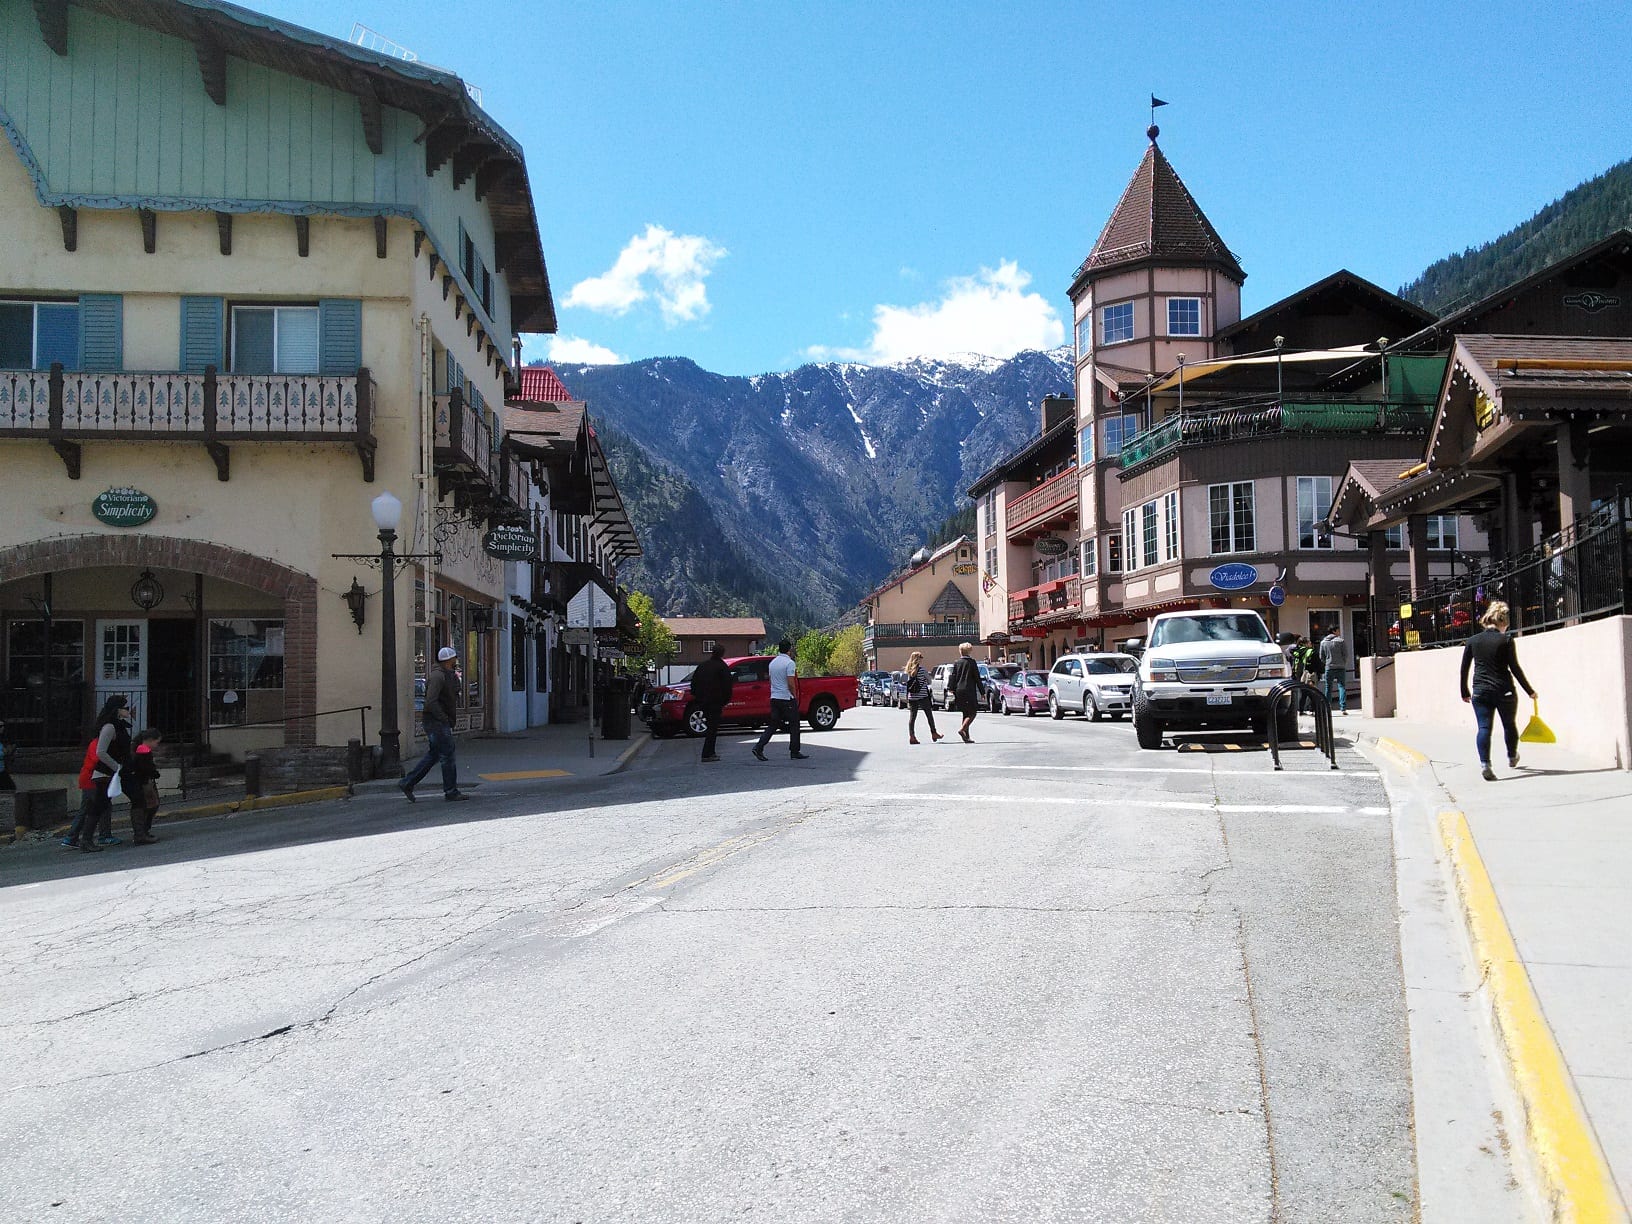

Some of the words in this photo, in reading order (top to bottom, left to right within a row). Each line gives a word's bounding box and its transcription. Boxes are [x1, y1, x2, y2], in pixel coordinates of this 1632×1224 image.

[107, 494, 142, 502] Victorian
[98, 502, 152, 518] Simplicity
[490, 532, 534, 544] Victorian
[487, 541, 534, 556] Simplicity
